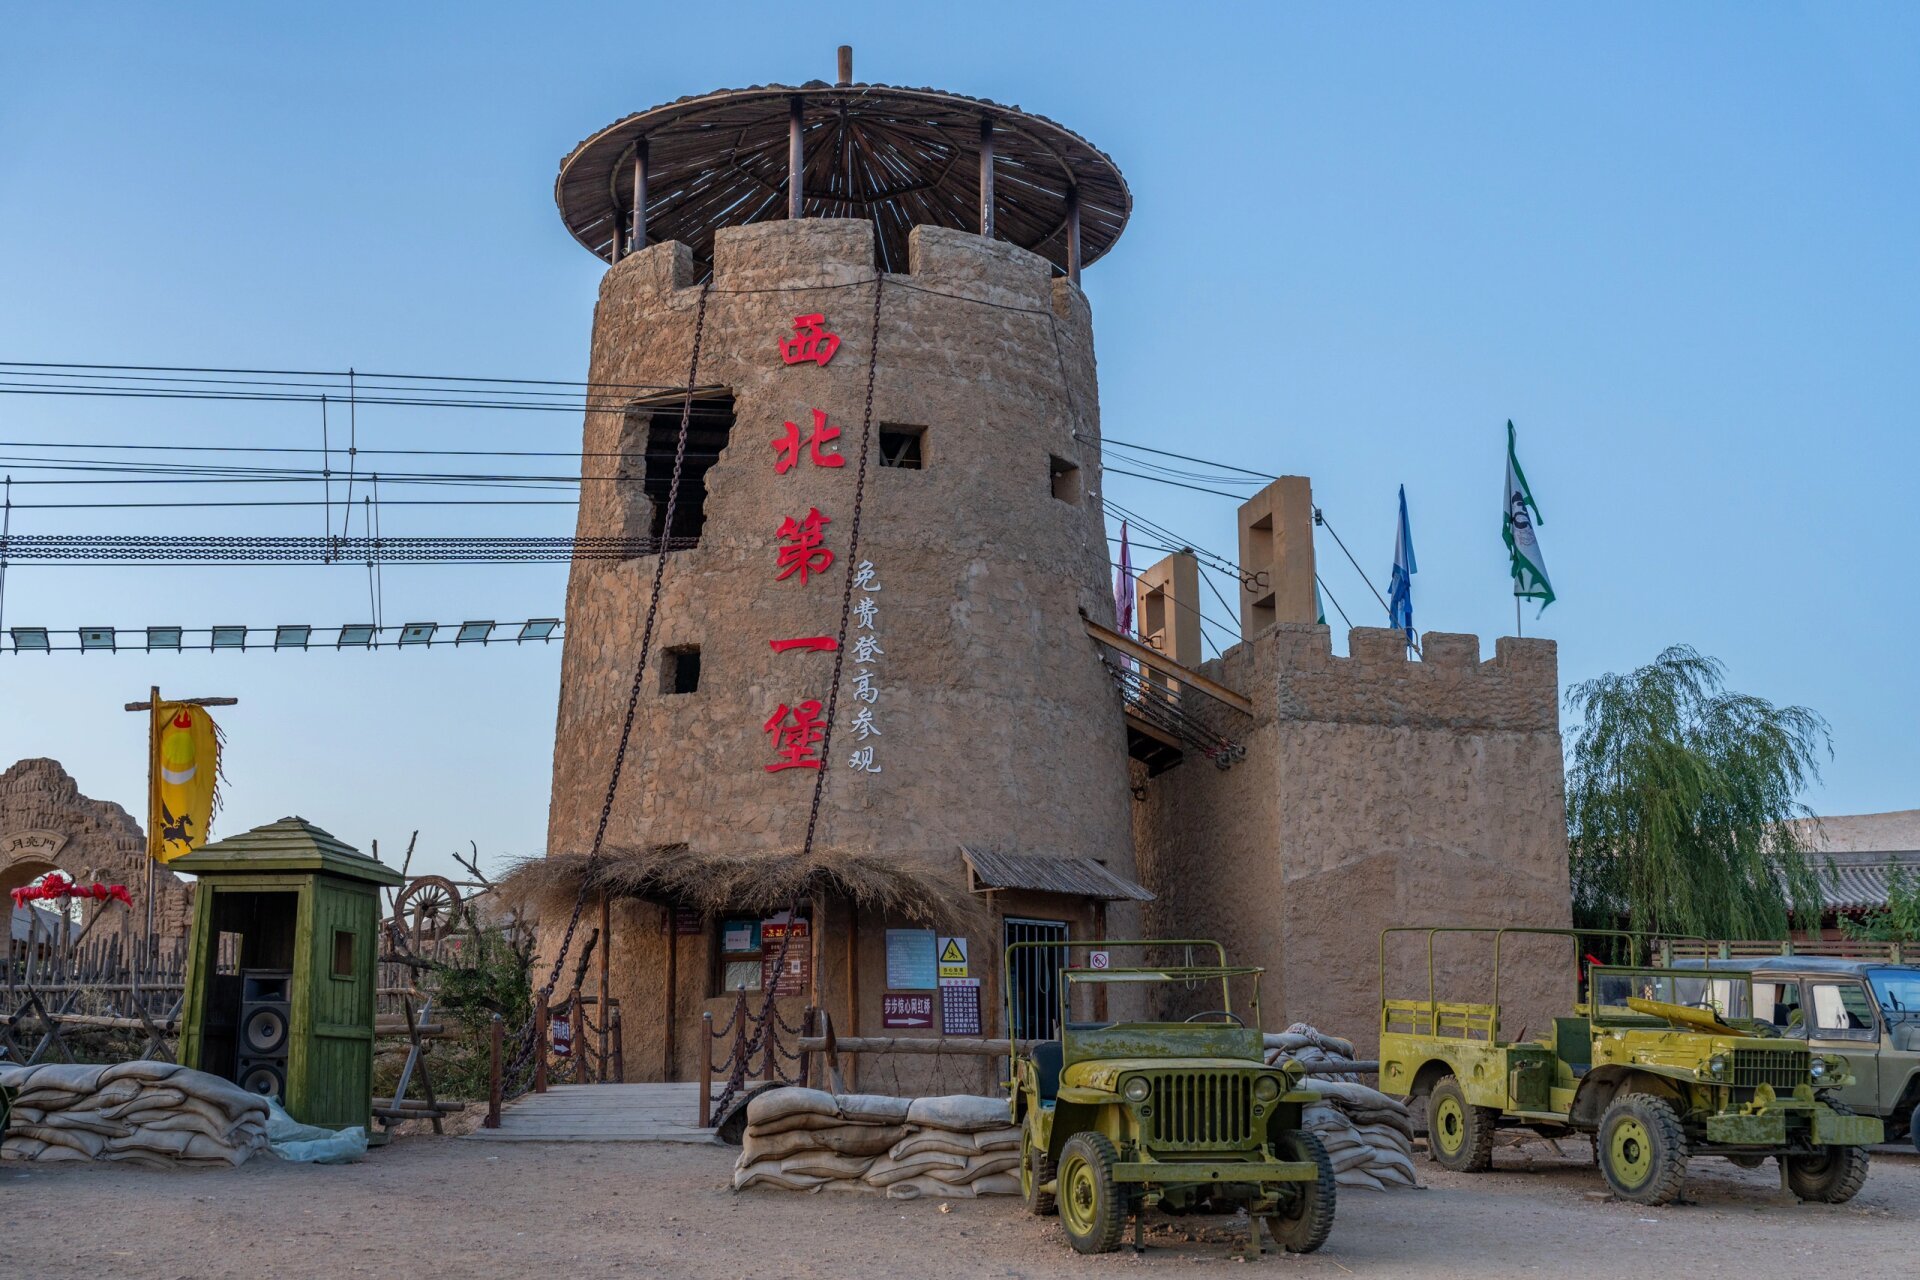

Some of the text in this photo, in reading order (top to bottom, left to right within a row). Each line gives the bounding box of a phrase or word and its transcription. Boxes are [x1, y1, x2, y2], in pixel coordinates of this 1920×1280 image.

[764, 313, 845, 772] 西北第一堡
[848, 560, 885, 774] 免费登高参观
[10, 836, 56, 852] 月亮門
[884, 997, 931, 1015] 步步惊心网红桥
